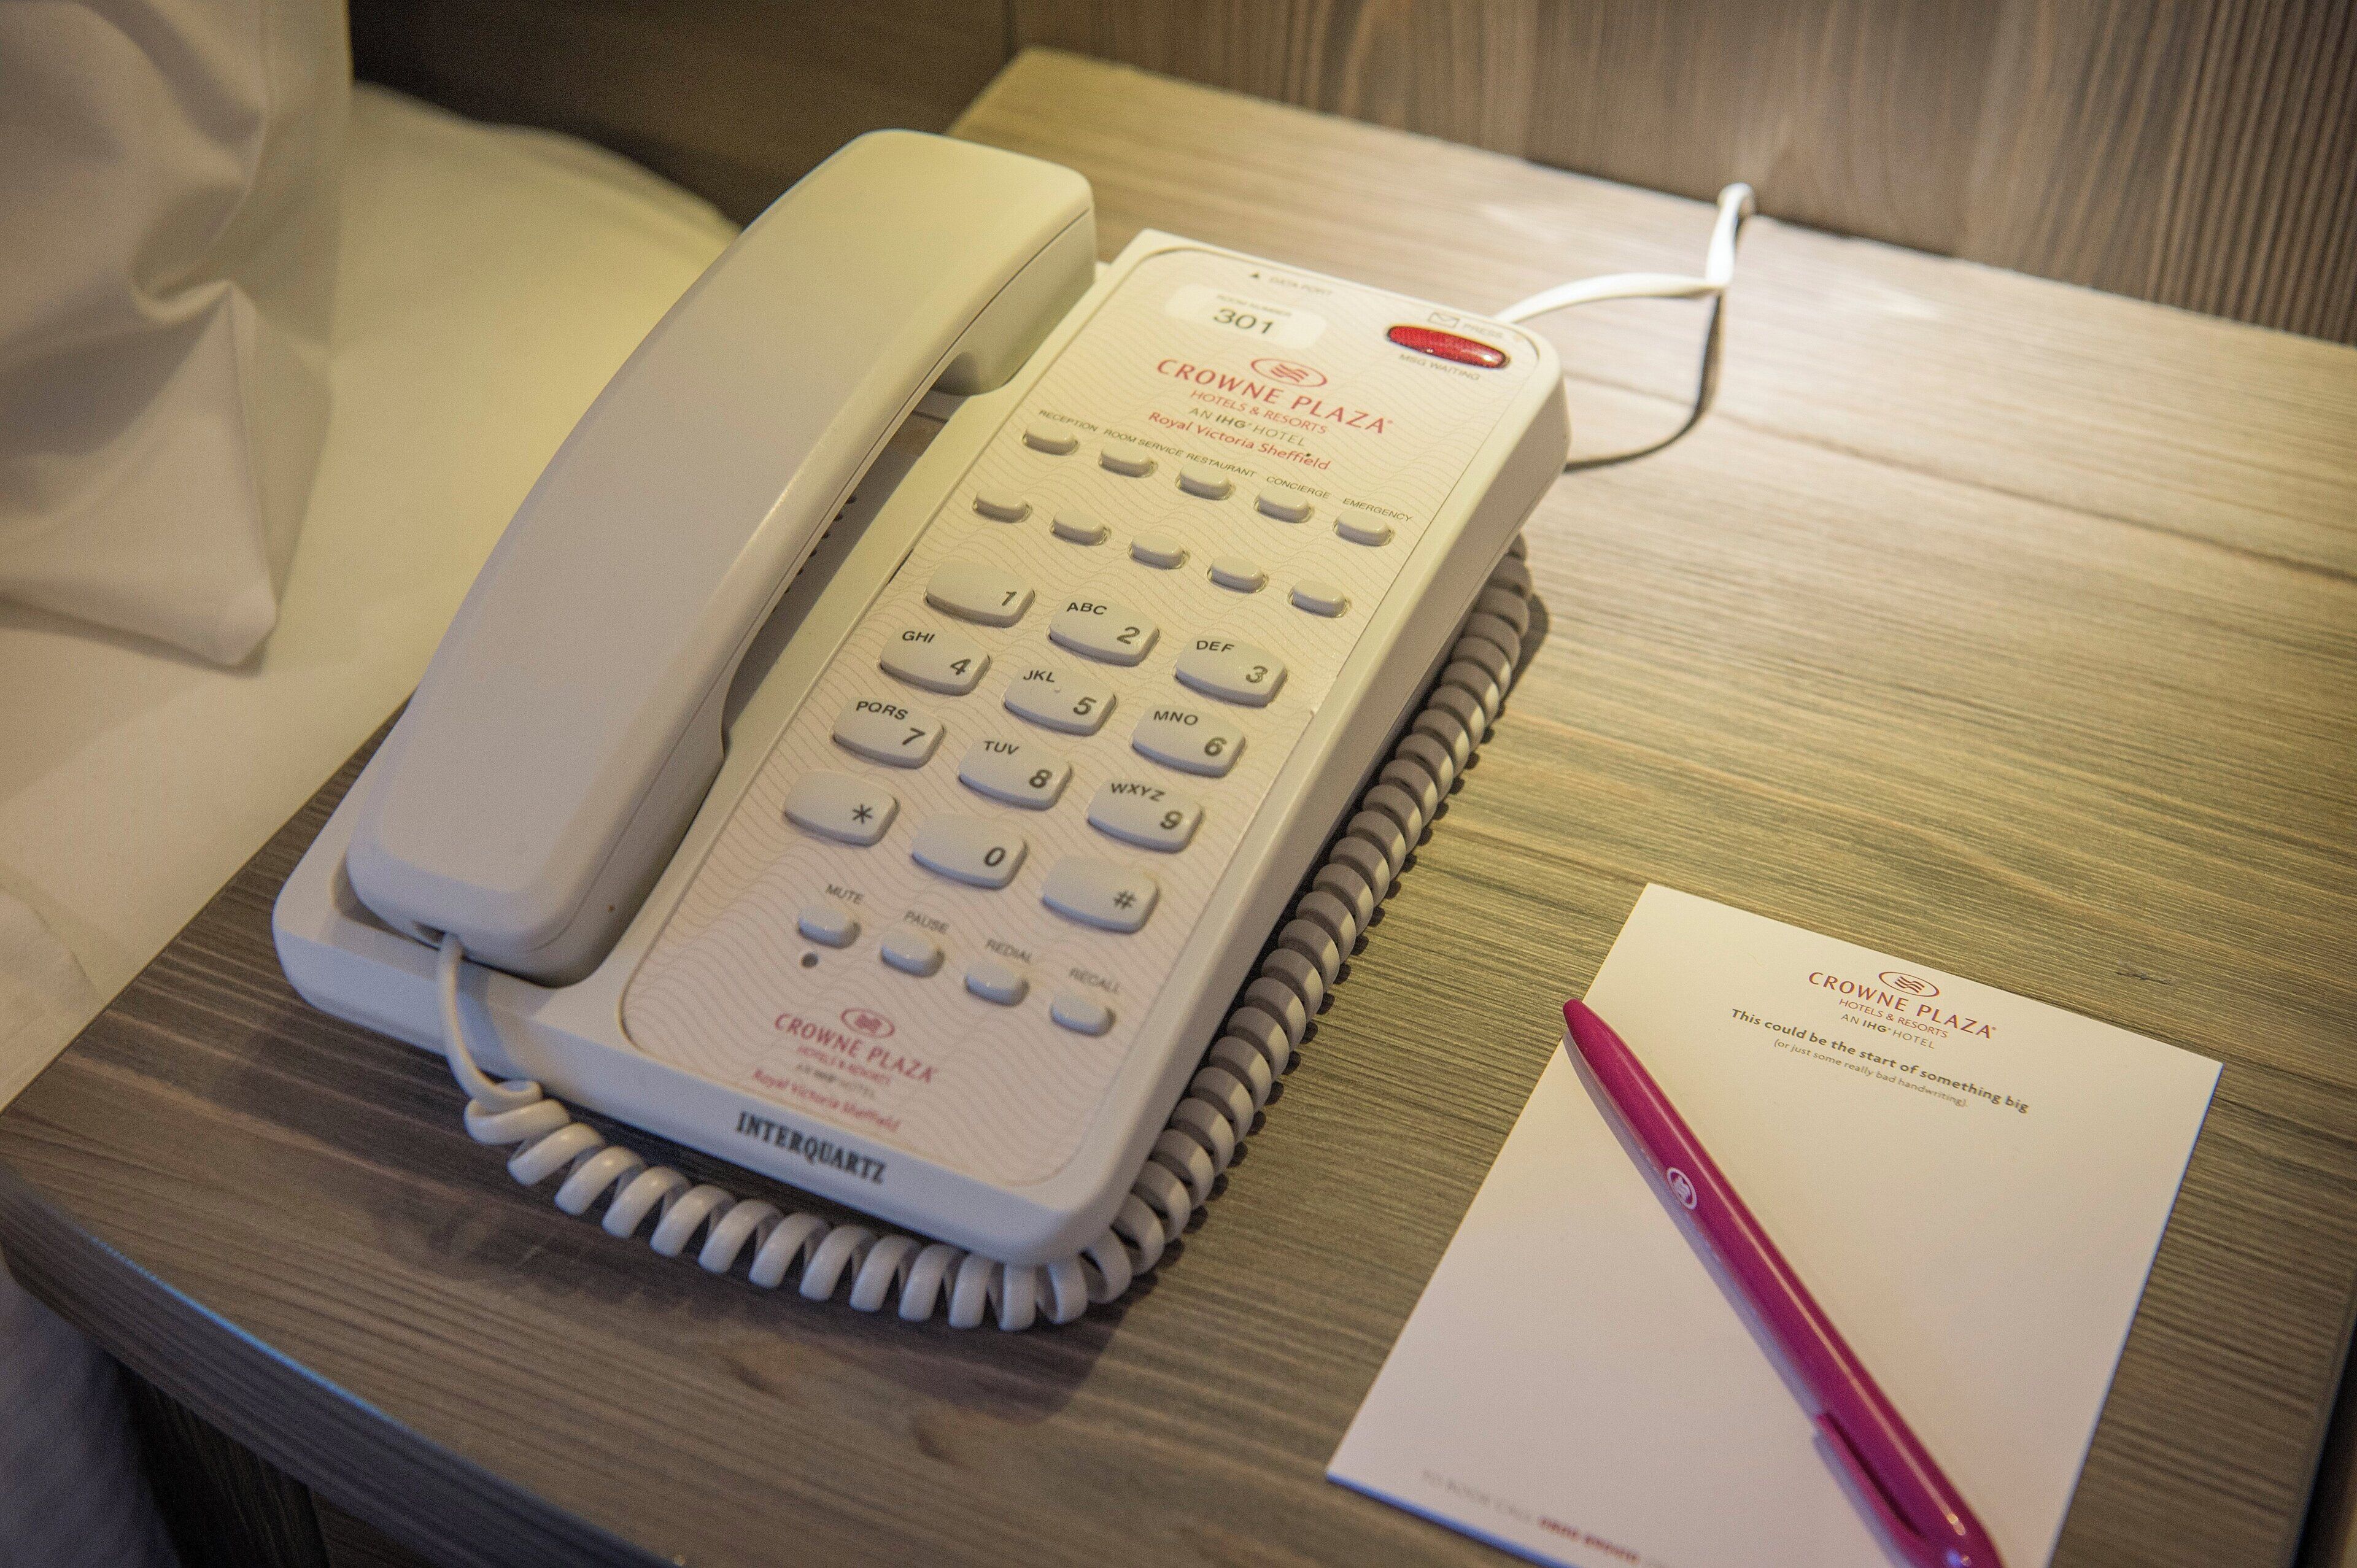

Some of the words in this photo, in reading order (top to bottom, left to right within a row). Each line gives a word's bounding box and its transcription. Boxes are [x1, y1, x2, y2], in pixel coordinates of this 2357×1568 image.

[1213, 308, 1274, 334] 301
[1399, 353, 1426, 366] MSG
[1430, 361, 1480, 380] WAITING
[1157, 358, 1283, 404] CROWNE
[1039, 409, 1098, 431] RECEPTION
[1191, 390, 1247, 413] HOTELS
[1250, 407, 1260, 415] &
[1264, 411, 1328, 434] RESORTS
[1188, 407, 1212, 420] AN
[1253, 425, 1306, 447] HOTEL
[1104, 429, 1136, 444] ROOM
[1138, 438, 1183, 457] SERVICE
[1148, 412, 1193, 431] Royal
[1196, 426, 1254, 449] Victoria
[1259, 443, 1331, 470] Sheffield
[1186, 452, 1257, 477] RESTAURANT
[1266, 476, 1332, 499] CONCIERGE
[1343, 498, 1412, 522] EMERGENCY
[1001, 591, 1018, 606] 1
[1066, 601, 1107, 615] ABC
[902, 630, 935, 643] GHI
[1117, 626, 1140, 644] 2
[1196, 640, 1234, 653] DEF
[950, 658, 970, 676] 4
[1023, 670, 1055, 683] JKL
[1245, 665, 1268, 684] 3
[856, 701, 908, 720] PQRS
[1073, 697, 1096, 716] 5
[1154, 710, 1198, 725] MNO
[901, 728, 924, 746] 7
[983, 741, 1020, 755] TUV
[1204, 736, 1227, 756] 6
[1029, 769, 1052, 788] 8
[1111, 783, 1165, 802] WXYZ
[1159, 811, 1182, 830] 9
[985, 847, 1005, 867] 0
[825, 884, 864, 904] MUTE
[1113, 890, 1136, 909] #
[904, 910, 949, 933] PAUSE
[986, 938, 1032, 963] REDIAL
[1069, 968, 1121, 992] RECALL
[1808, 971, 1910, 1012] CROWNE
[1839, 998, 1883, 1019] HOTELS
[1898, 1017, 1948, 1038] RESORTS
[775, 1013, 864, 1058] CROWNE
[1841, 1014, 1859, 1024] AN
[1892, 1029, 1935, 1049] HOTEL
[1732, 1008, 1760, 1025] This
[1764, 1020, 1807, 1039] could
[1809, 1032, 1828, 1046] be
[1832, 1040, 1856, 1055] the
[1859, 1049, 1896, 1068] start
[1900, 1062, 1919, 1075] of
[1919, 1068, 2002, 1105] something
[2005, 1094, 2029, 1114] big
[1773, 1038, 1789, 1049] (or
[1790, 1043, 1811, 1057] just
[1814, 1052, 1841, 1066] some
[1844, 1060, 1874, 1076] really
[1876, 1070, 1895, 1084] bad
[737, 1110, 886, 1185] INTERQUARTZ
